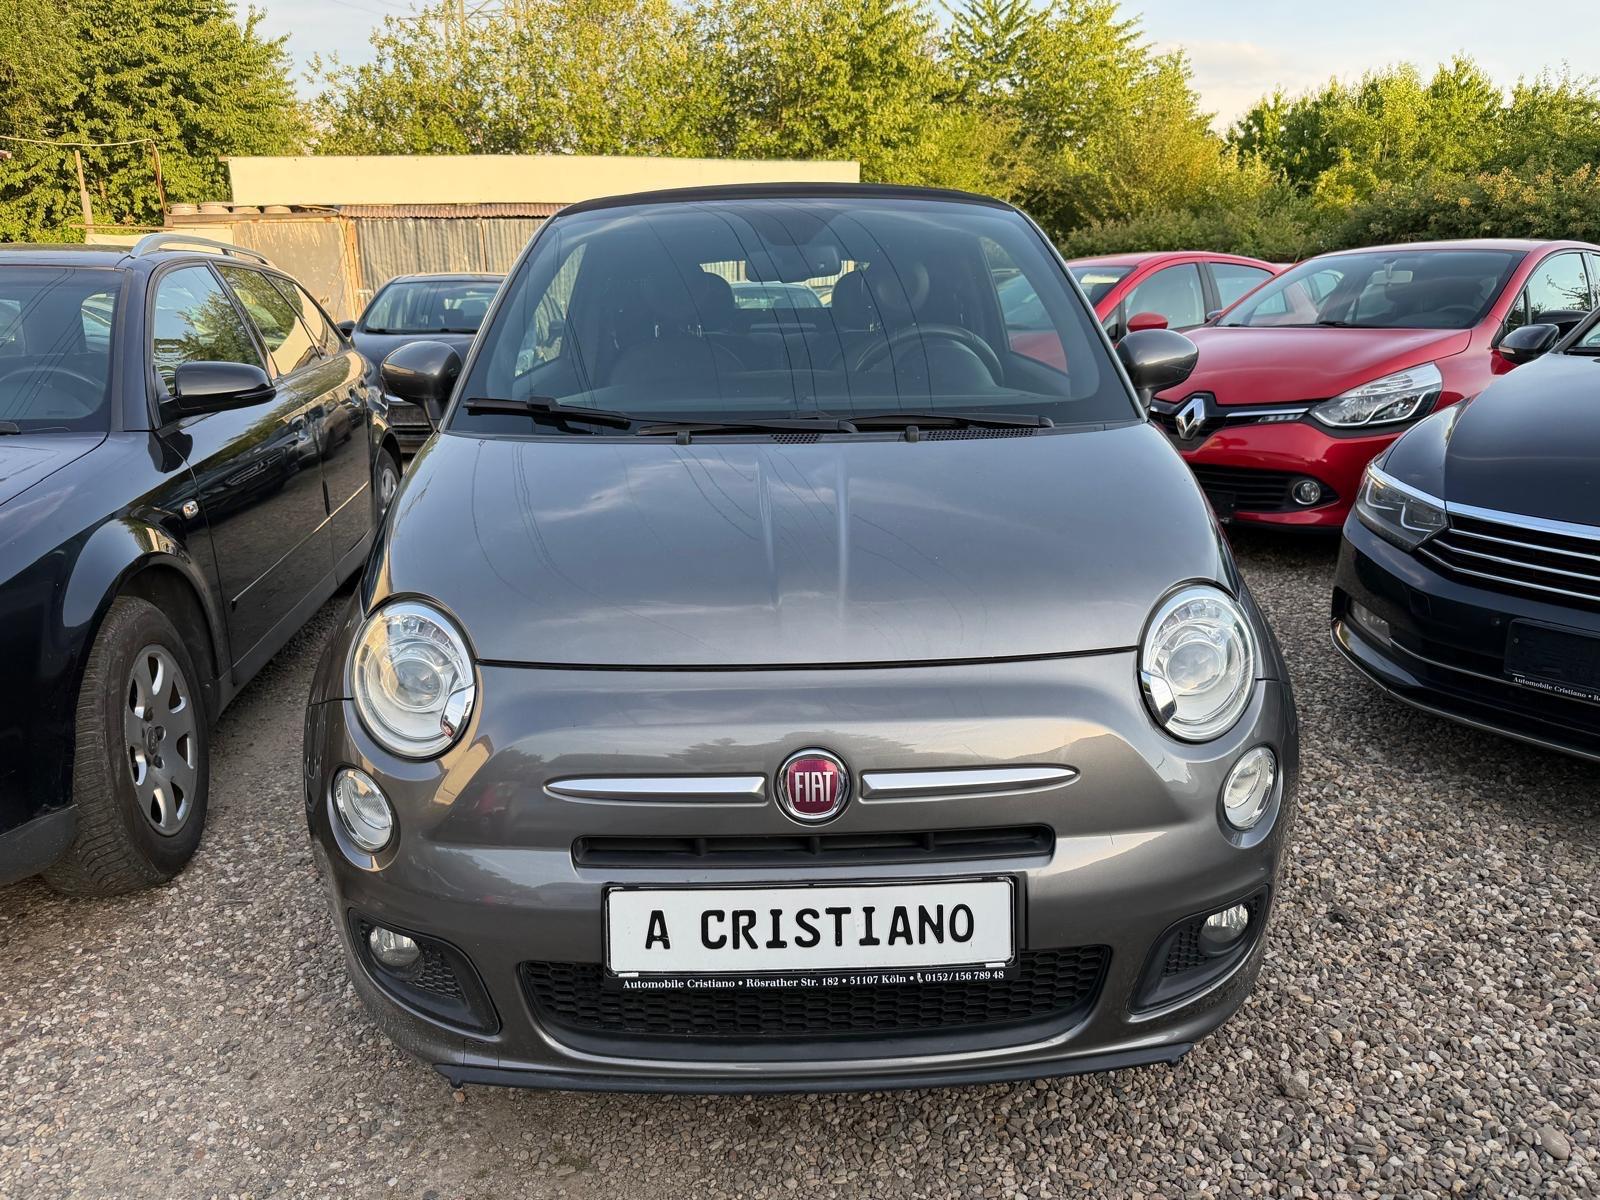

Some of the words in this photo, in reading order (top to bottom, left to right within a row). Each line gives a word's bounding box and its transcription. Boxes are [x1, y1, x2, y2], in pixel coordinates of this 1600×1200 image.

[1514, 677, 1553, 690] Automobile
[1554, 686, 1587, 697] Cristiano
[795, 772, 833, 802] FIAT
[645, 910, 671, 950] A
[701, 903, 975, 950] CRISTIANO
[623, 979, 685, 989] Automobile
[687, 978, 736, 988] Cristiano
[746, 978, 799, 988] Rösrather
[800, 977, 819, 987] Str.
[822, 976, 839, 986] 182
[849, 975, 879, 985] 51107
[881, 974, 907, 984] Köln
